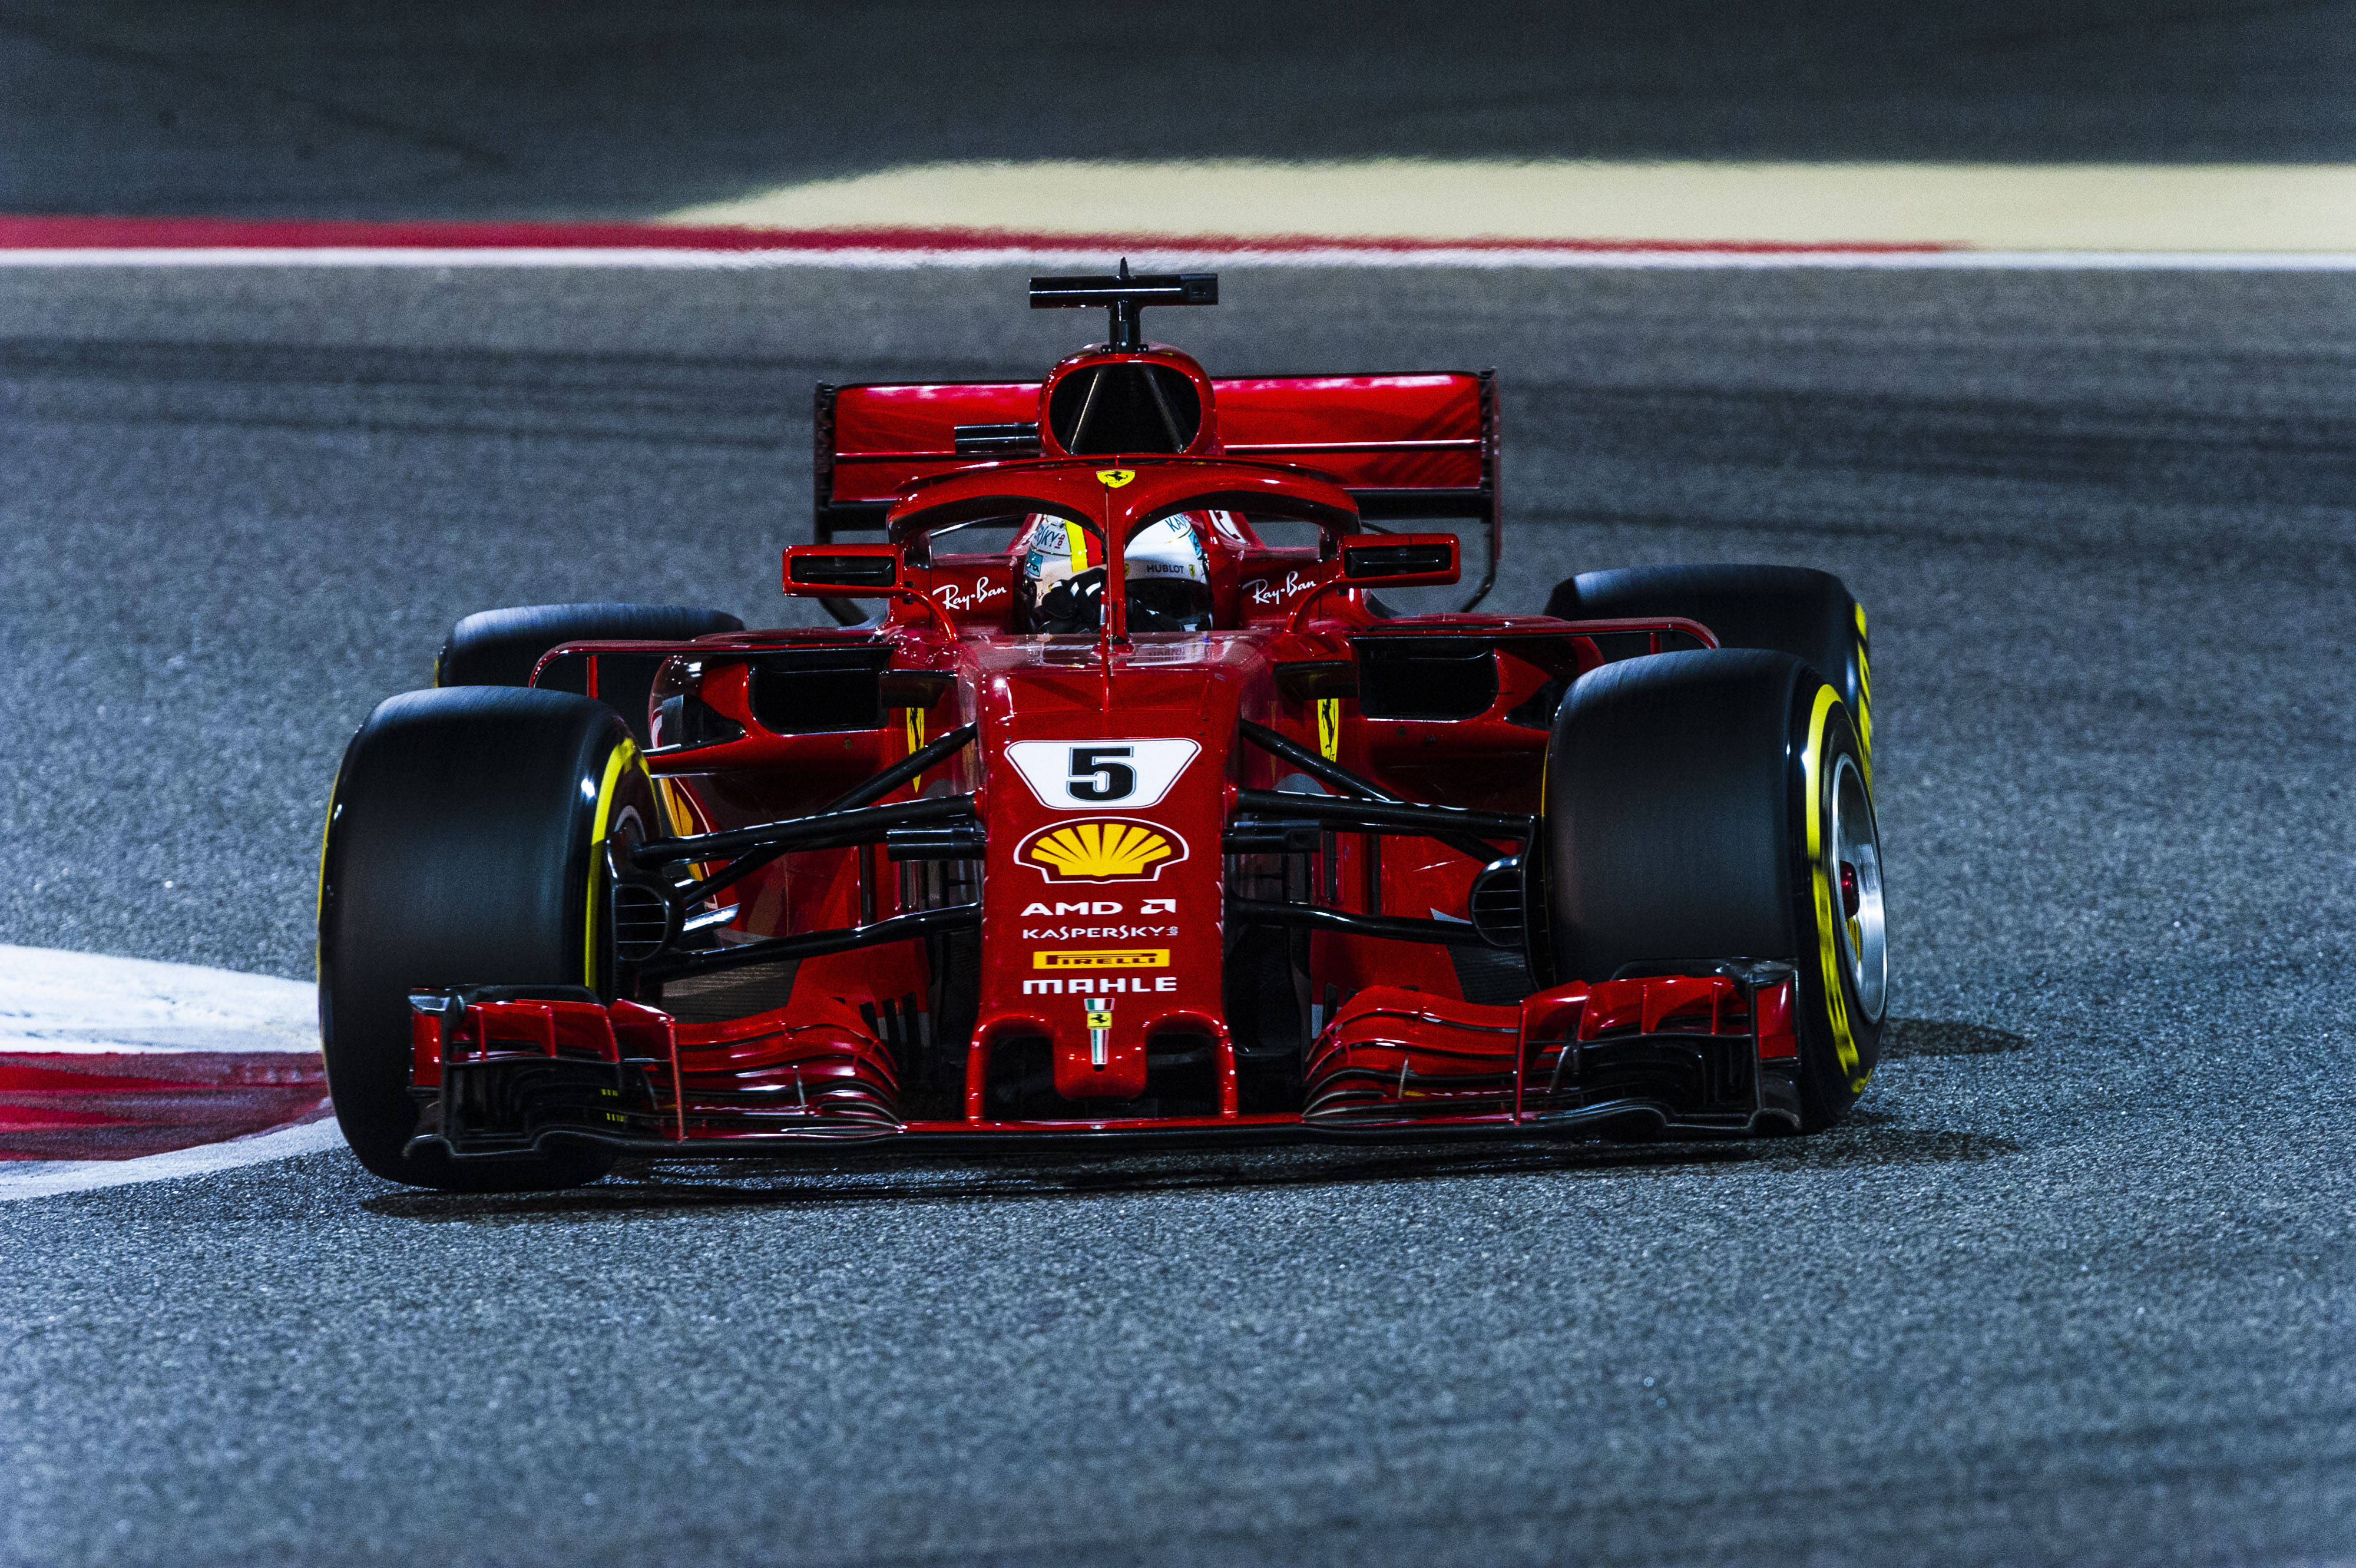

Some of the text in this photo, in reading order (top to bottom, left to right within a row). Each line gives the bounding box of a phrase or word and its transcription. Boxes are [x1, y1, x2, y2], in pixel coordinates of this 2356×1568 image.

[1146, 564, 1184, 574] HUBLOT
[932, 576, 1007, 611] Ray-Ban
[1242, 570, 1317, 605] Ray-Ban
[1066, 746, 1137, 803] 5
[1020, 901, 1123, 917] AMD
[1023, 925, 1165, 941] KASPERSKY
[1045, 952, 1157, 965] PIRELLI
[1023, 977, 1177, 995] MAHLE
